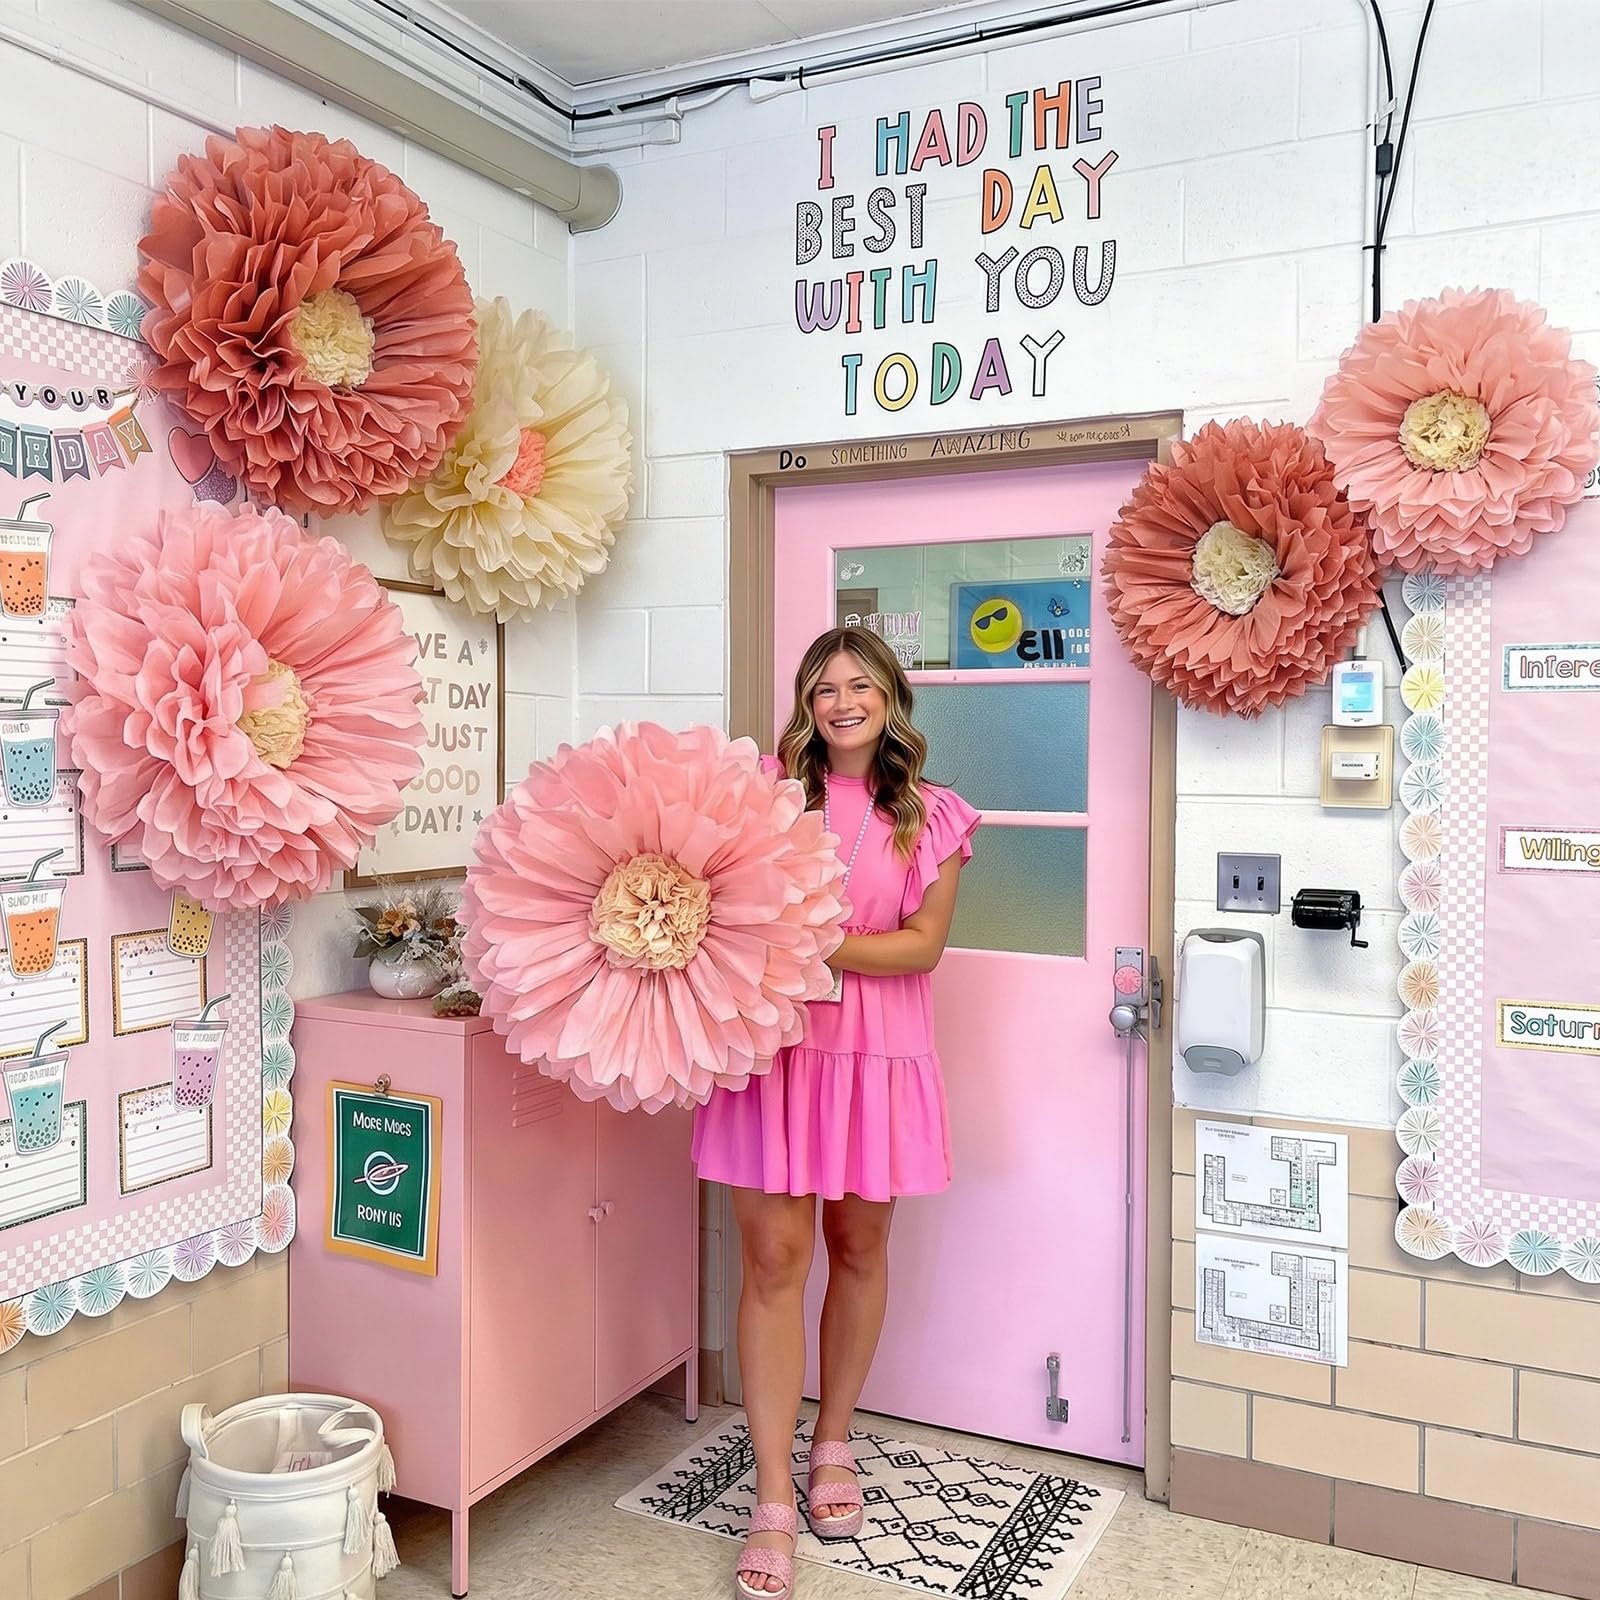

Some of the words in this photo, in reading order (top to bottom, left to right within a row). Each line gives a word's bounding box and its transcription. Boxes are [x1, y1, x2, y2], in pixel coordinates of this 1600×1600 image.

[818, 125, 836, 190] I
[876, 102, 987, 177] HAD
[1006, 76, 1103, 158] THE
[796, 183, 927, 266] BEST
[981, 150, 1119, 235] DAY
[795, 259, 938, 334] WITH
[975, 240, 1116, 313] YOU
[842, 330, 1065, 415] TODAY
[15, 384, 109, 406] YOUR
[831, 443, 908, 465] SOMETHING
[415, 632, 447, 659] VE
[457, 640, 473, 666] A
[449, 682, 491, 710] DAY
[426, 722, 488, 752] JUST
[405, 805, 463, 834] DAY!
